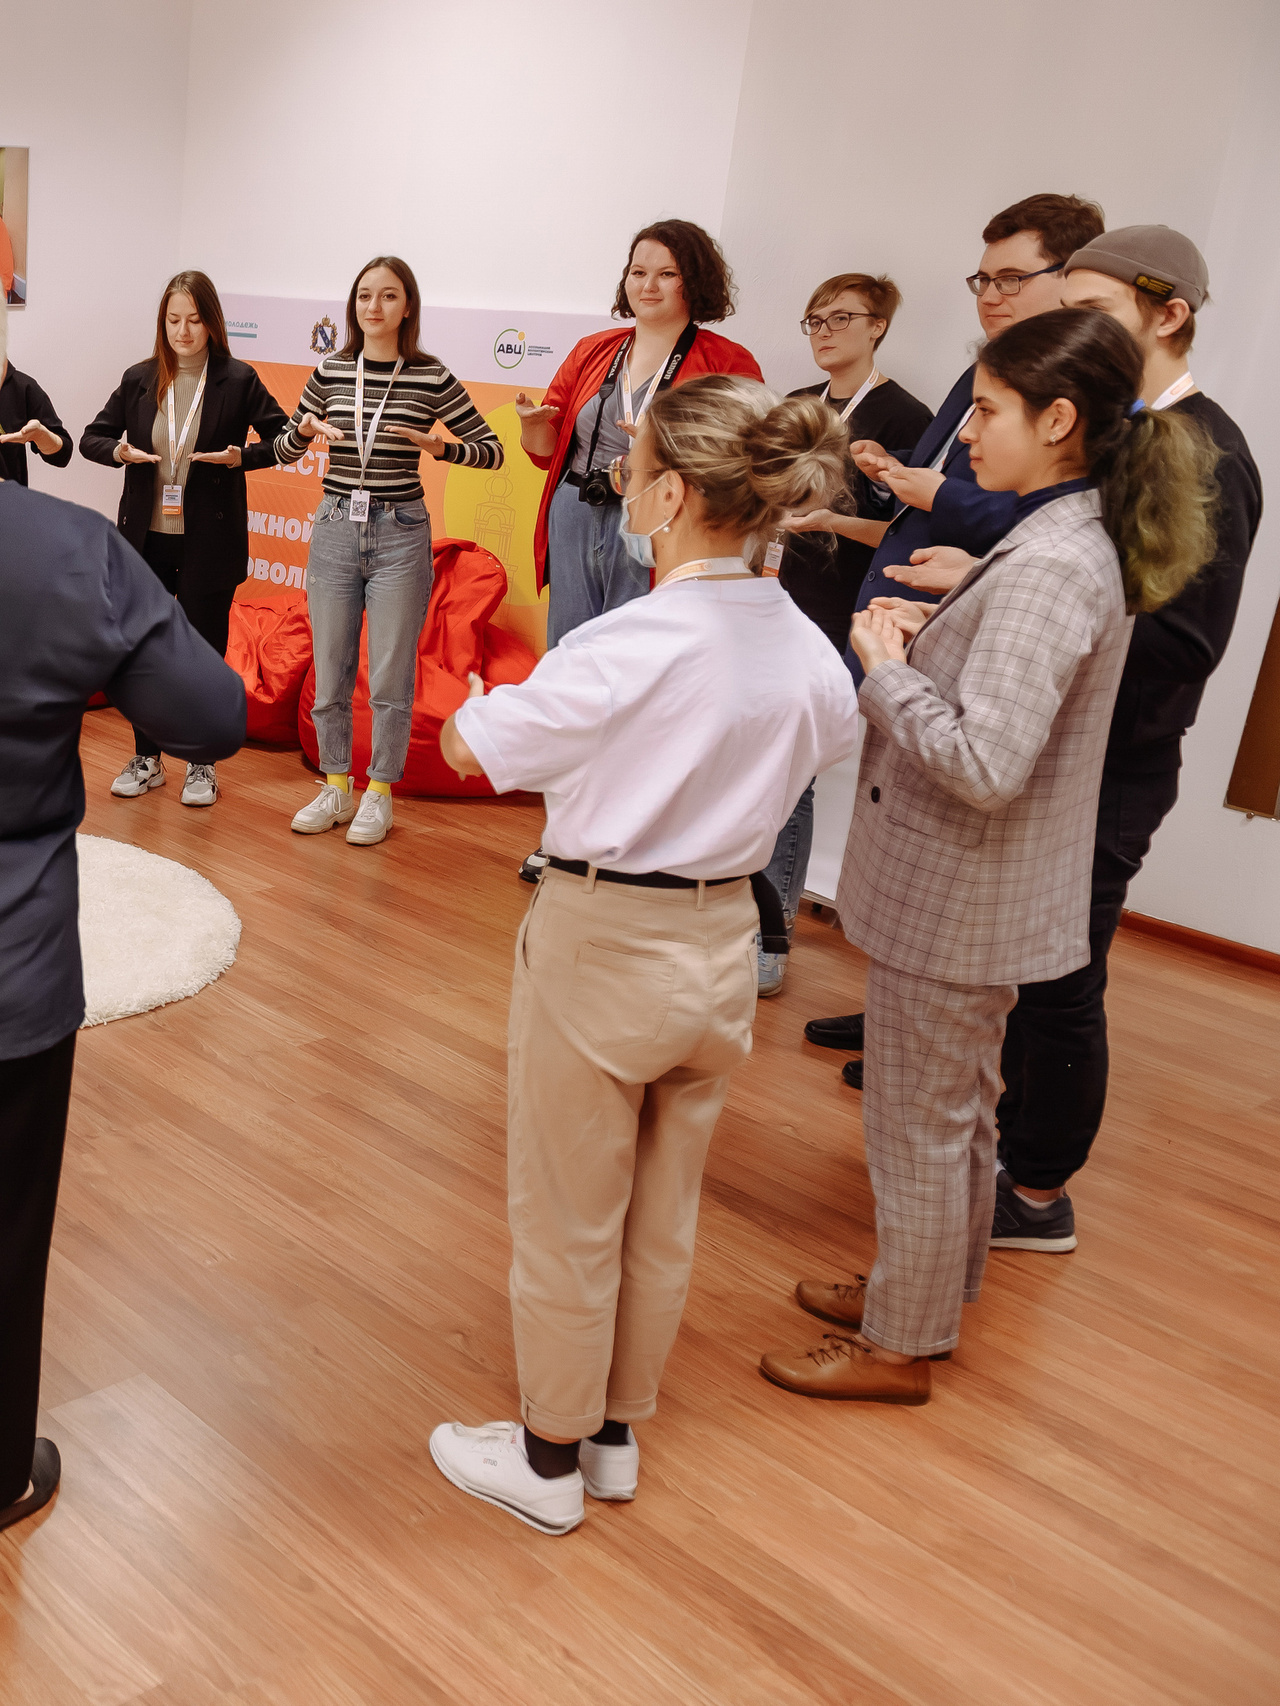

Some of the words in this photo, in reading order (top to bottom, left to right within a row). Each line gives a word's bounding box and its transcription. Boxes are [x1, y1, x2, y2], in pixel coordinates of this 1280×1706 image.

[497, 343, 522, 355] АВЦ
[663, 353, 682, 380] Canon
[247, 556, 307, 590] ВОЛ
